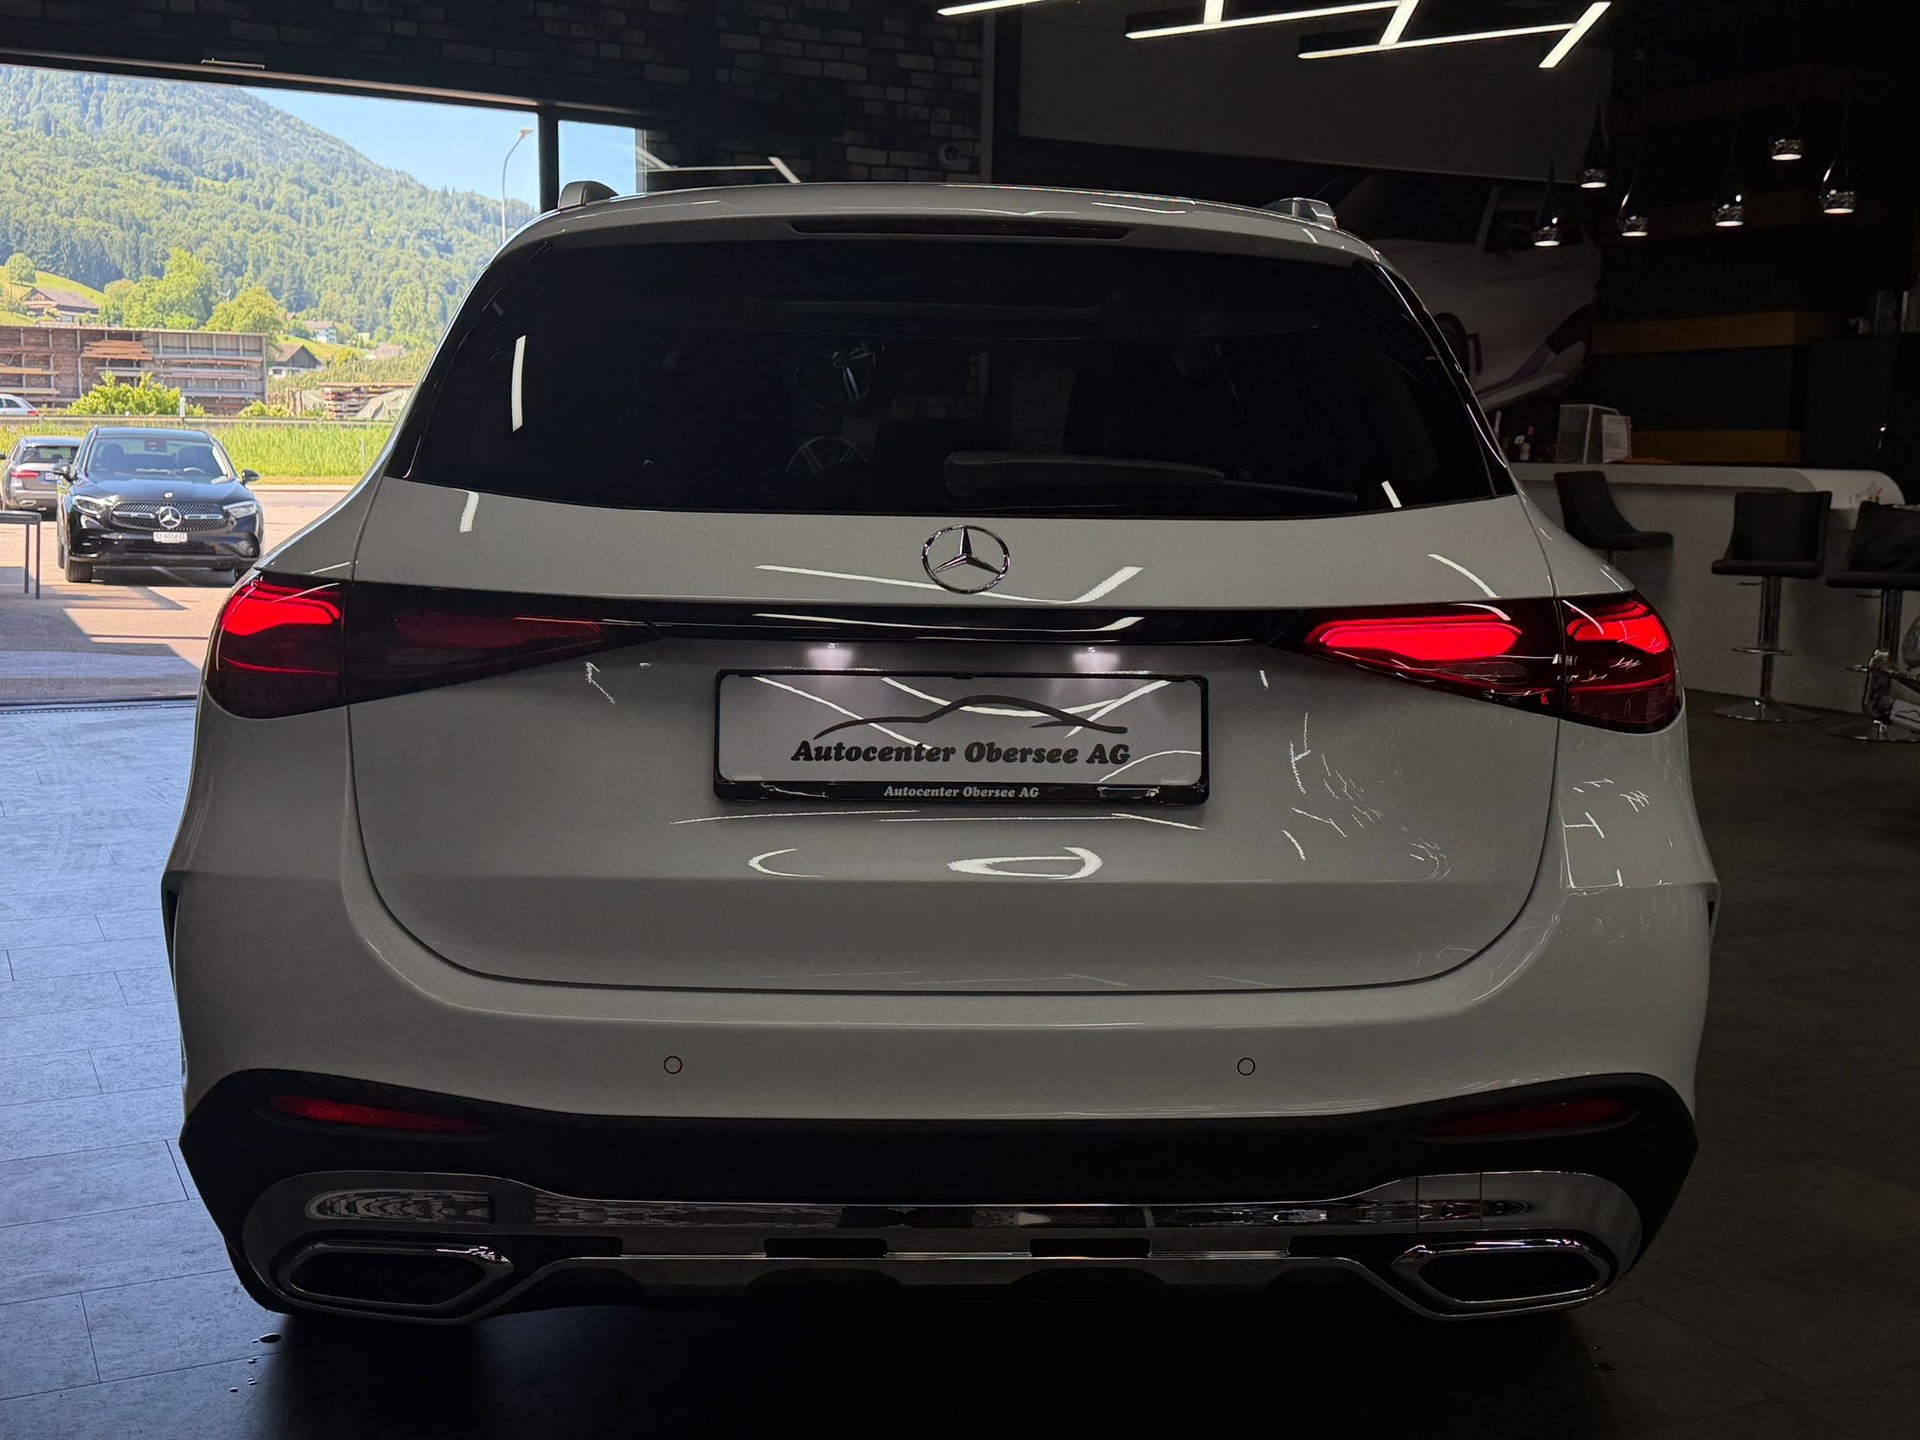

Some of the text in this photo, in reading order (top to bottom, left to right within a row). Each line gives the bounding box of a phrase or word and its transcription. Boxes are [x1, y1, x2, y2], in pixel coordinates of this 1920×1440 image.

[790, 740, 1131, 766] Autocenter Obersee AG
[883, 785, 1040, 799] Autocenter Obersee AG
